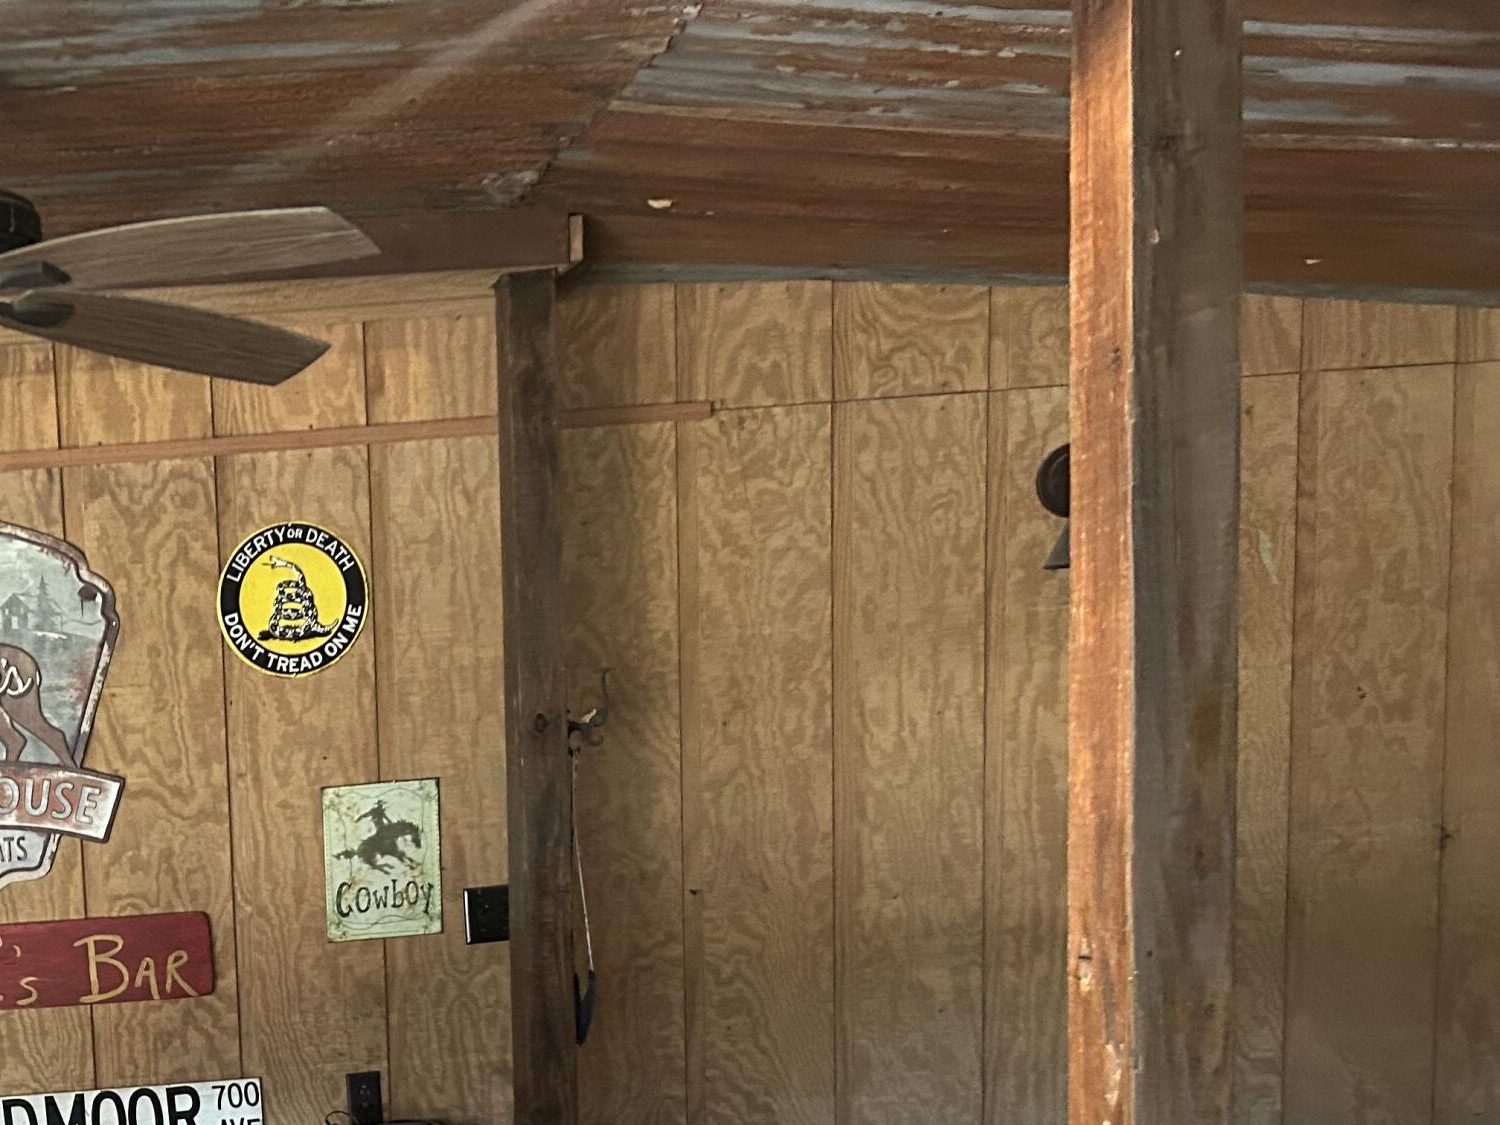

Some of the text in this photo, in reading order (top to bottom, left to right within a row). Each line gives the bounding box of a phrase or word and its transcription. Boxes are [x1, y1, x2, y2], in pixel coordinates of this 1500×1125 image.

[226, 526, 355, 583] LIBERTY OR DEATH
[224, 604, 362, 672] DON'T TREAD ON ME
[212, 1081, 260, 1111] 700
